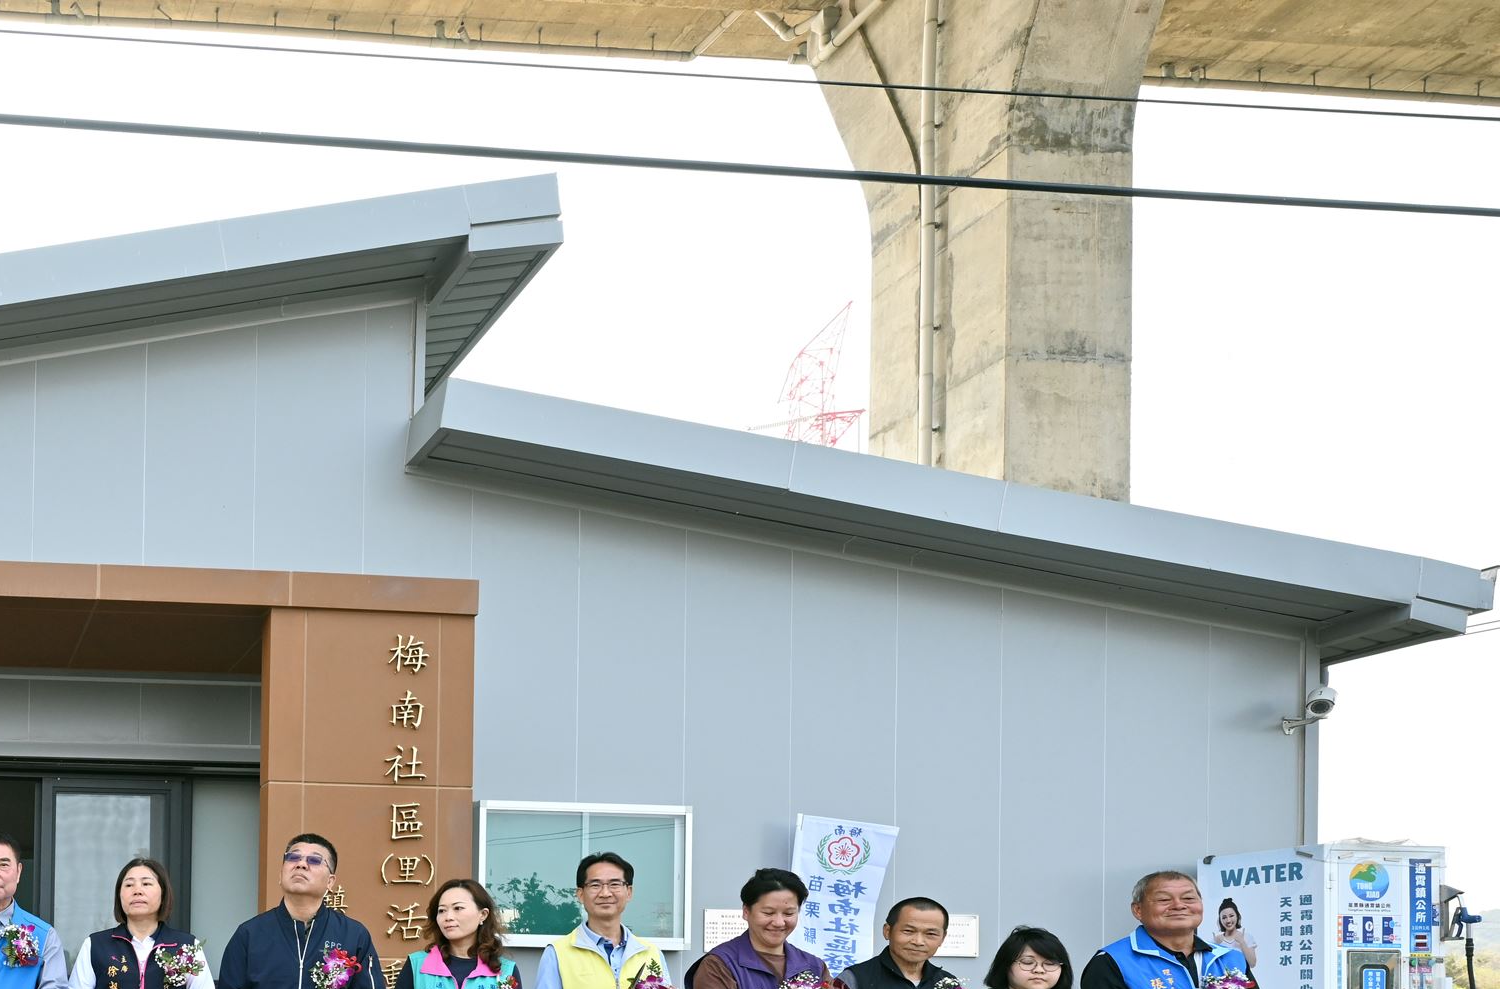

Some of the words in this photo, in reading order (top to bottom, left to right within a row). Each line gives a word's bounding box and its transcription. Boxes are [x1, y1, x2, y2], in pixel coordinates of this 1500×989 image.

[1220, 862, 1304, 888] WATER
[1414, 862, 1427, 923] 通霄鎮公所
[325, 940, 342, 950] CPC
[1279, 896, 1293, 967] 天天喝好水
